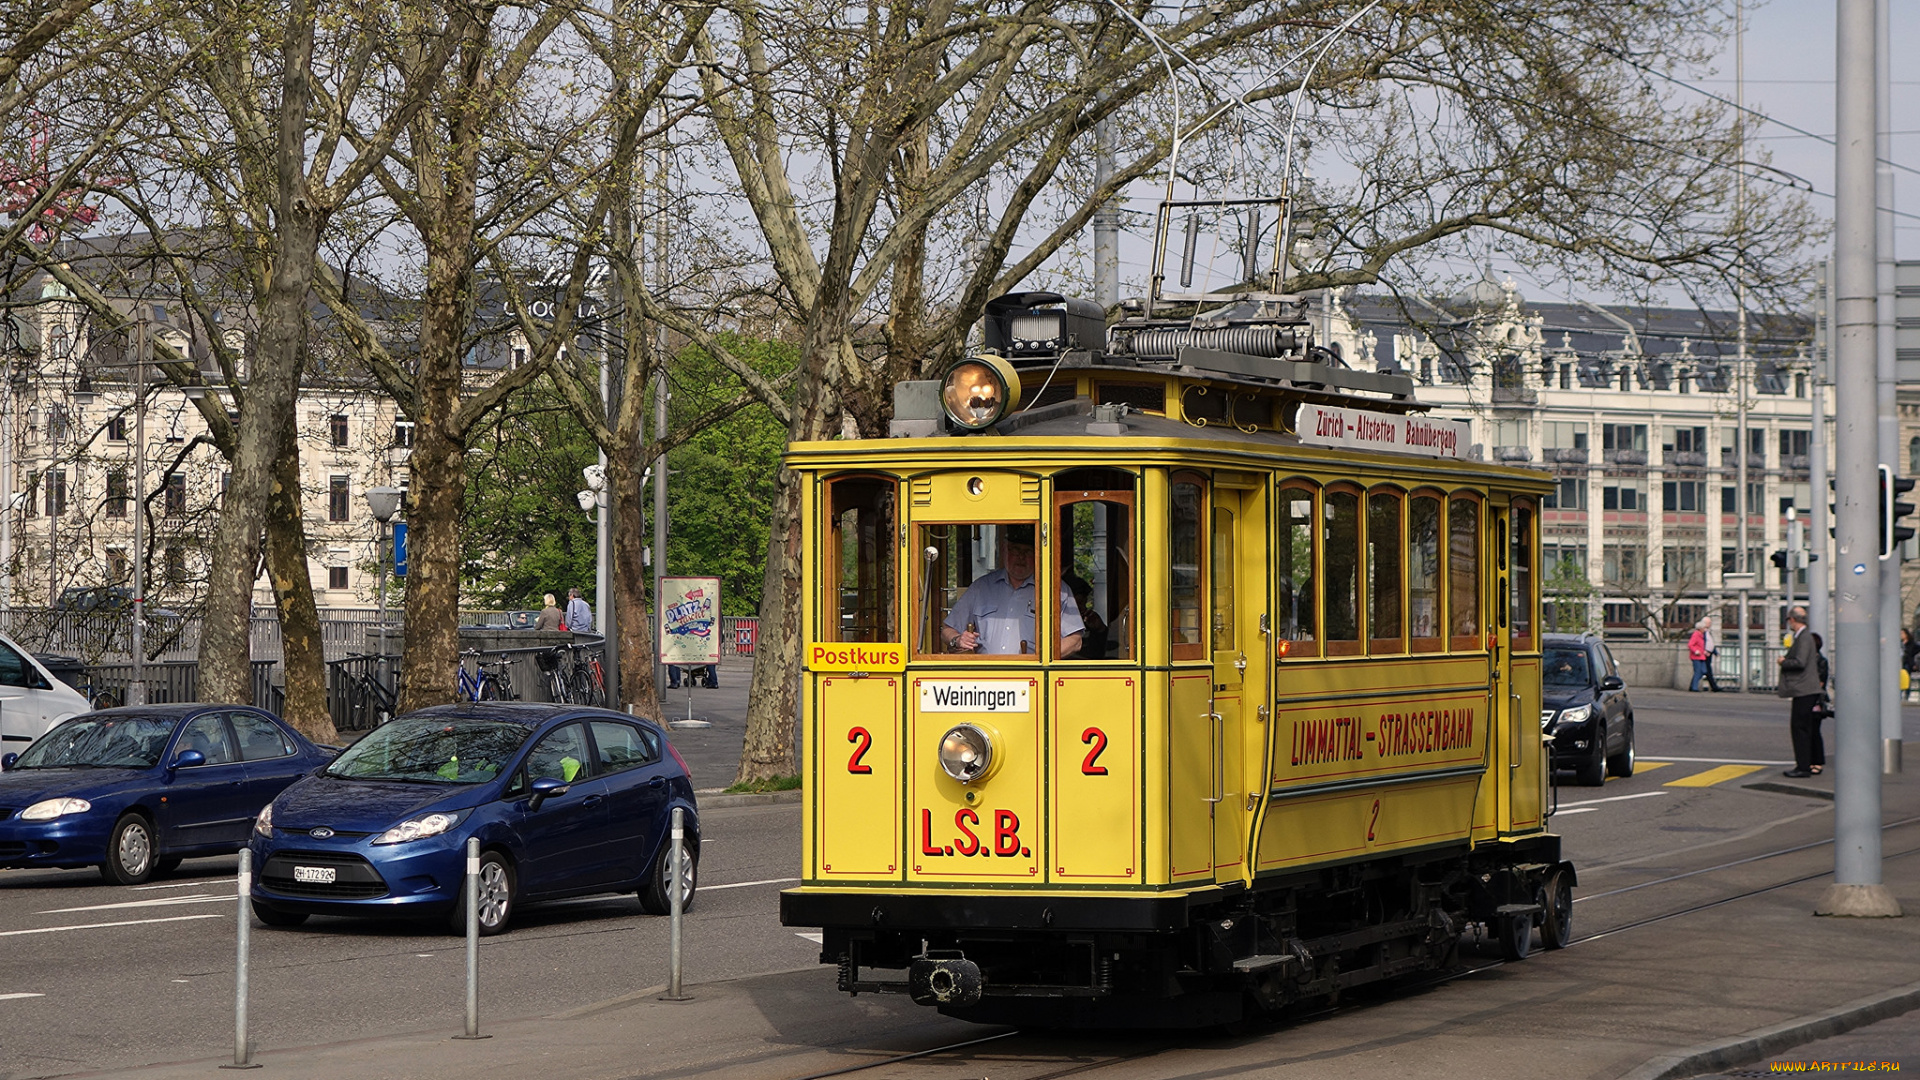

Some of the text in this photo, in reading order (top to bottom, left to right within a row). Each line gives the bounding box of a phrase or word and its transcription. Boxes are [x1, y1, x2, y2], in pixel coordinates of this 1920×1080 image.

[1316, 410, 1344, 438] Zürich
[1356, 414, 1396, 443] Altstetten
[1405, 420, 1457, 456] Bahnübergang
[665, 600, 702, 623] PLATZ
[813, 647, 900, 665] Postkurs
[932, 685, 1016, 711] Weiningen
[847, 726, 872, 774] 2
[1081, 726, 1109, 776] 2
[1291, 716, 1363, 766] LIMMATTAL
[1378, 708, 1474, 757] STRASSENBAHN
[922, 808, 1031, 858] L.S.B.
[1367, 799, 1380, 841] 2
